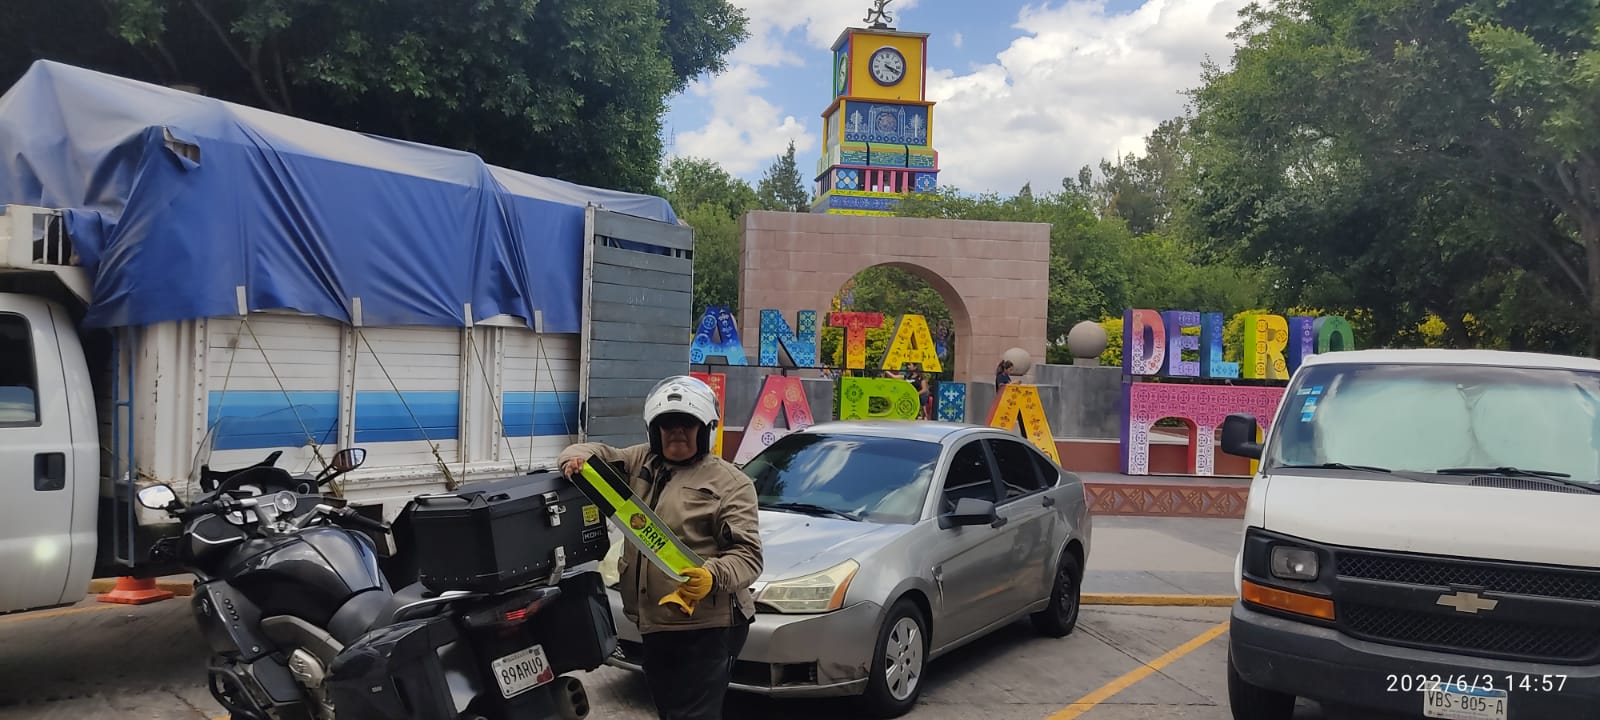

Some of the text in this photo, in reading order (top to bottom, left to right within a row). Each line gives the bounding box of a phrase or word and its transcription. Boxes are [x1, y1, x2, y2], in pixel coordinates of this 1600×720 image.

[642, 525, 666, 549] RRM
[501, 655, 544, 685] 89ARU9
[1427, 690, 1504, 715] VBS-805-A
